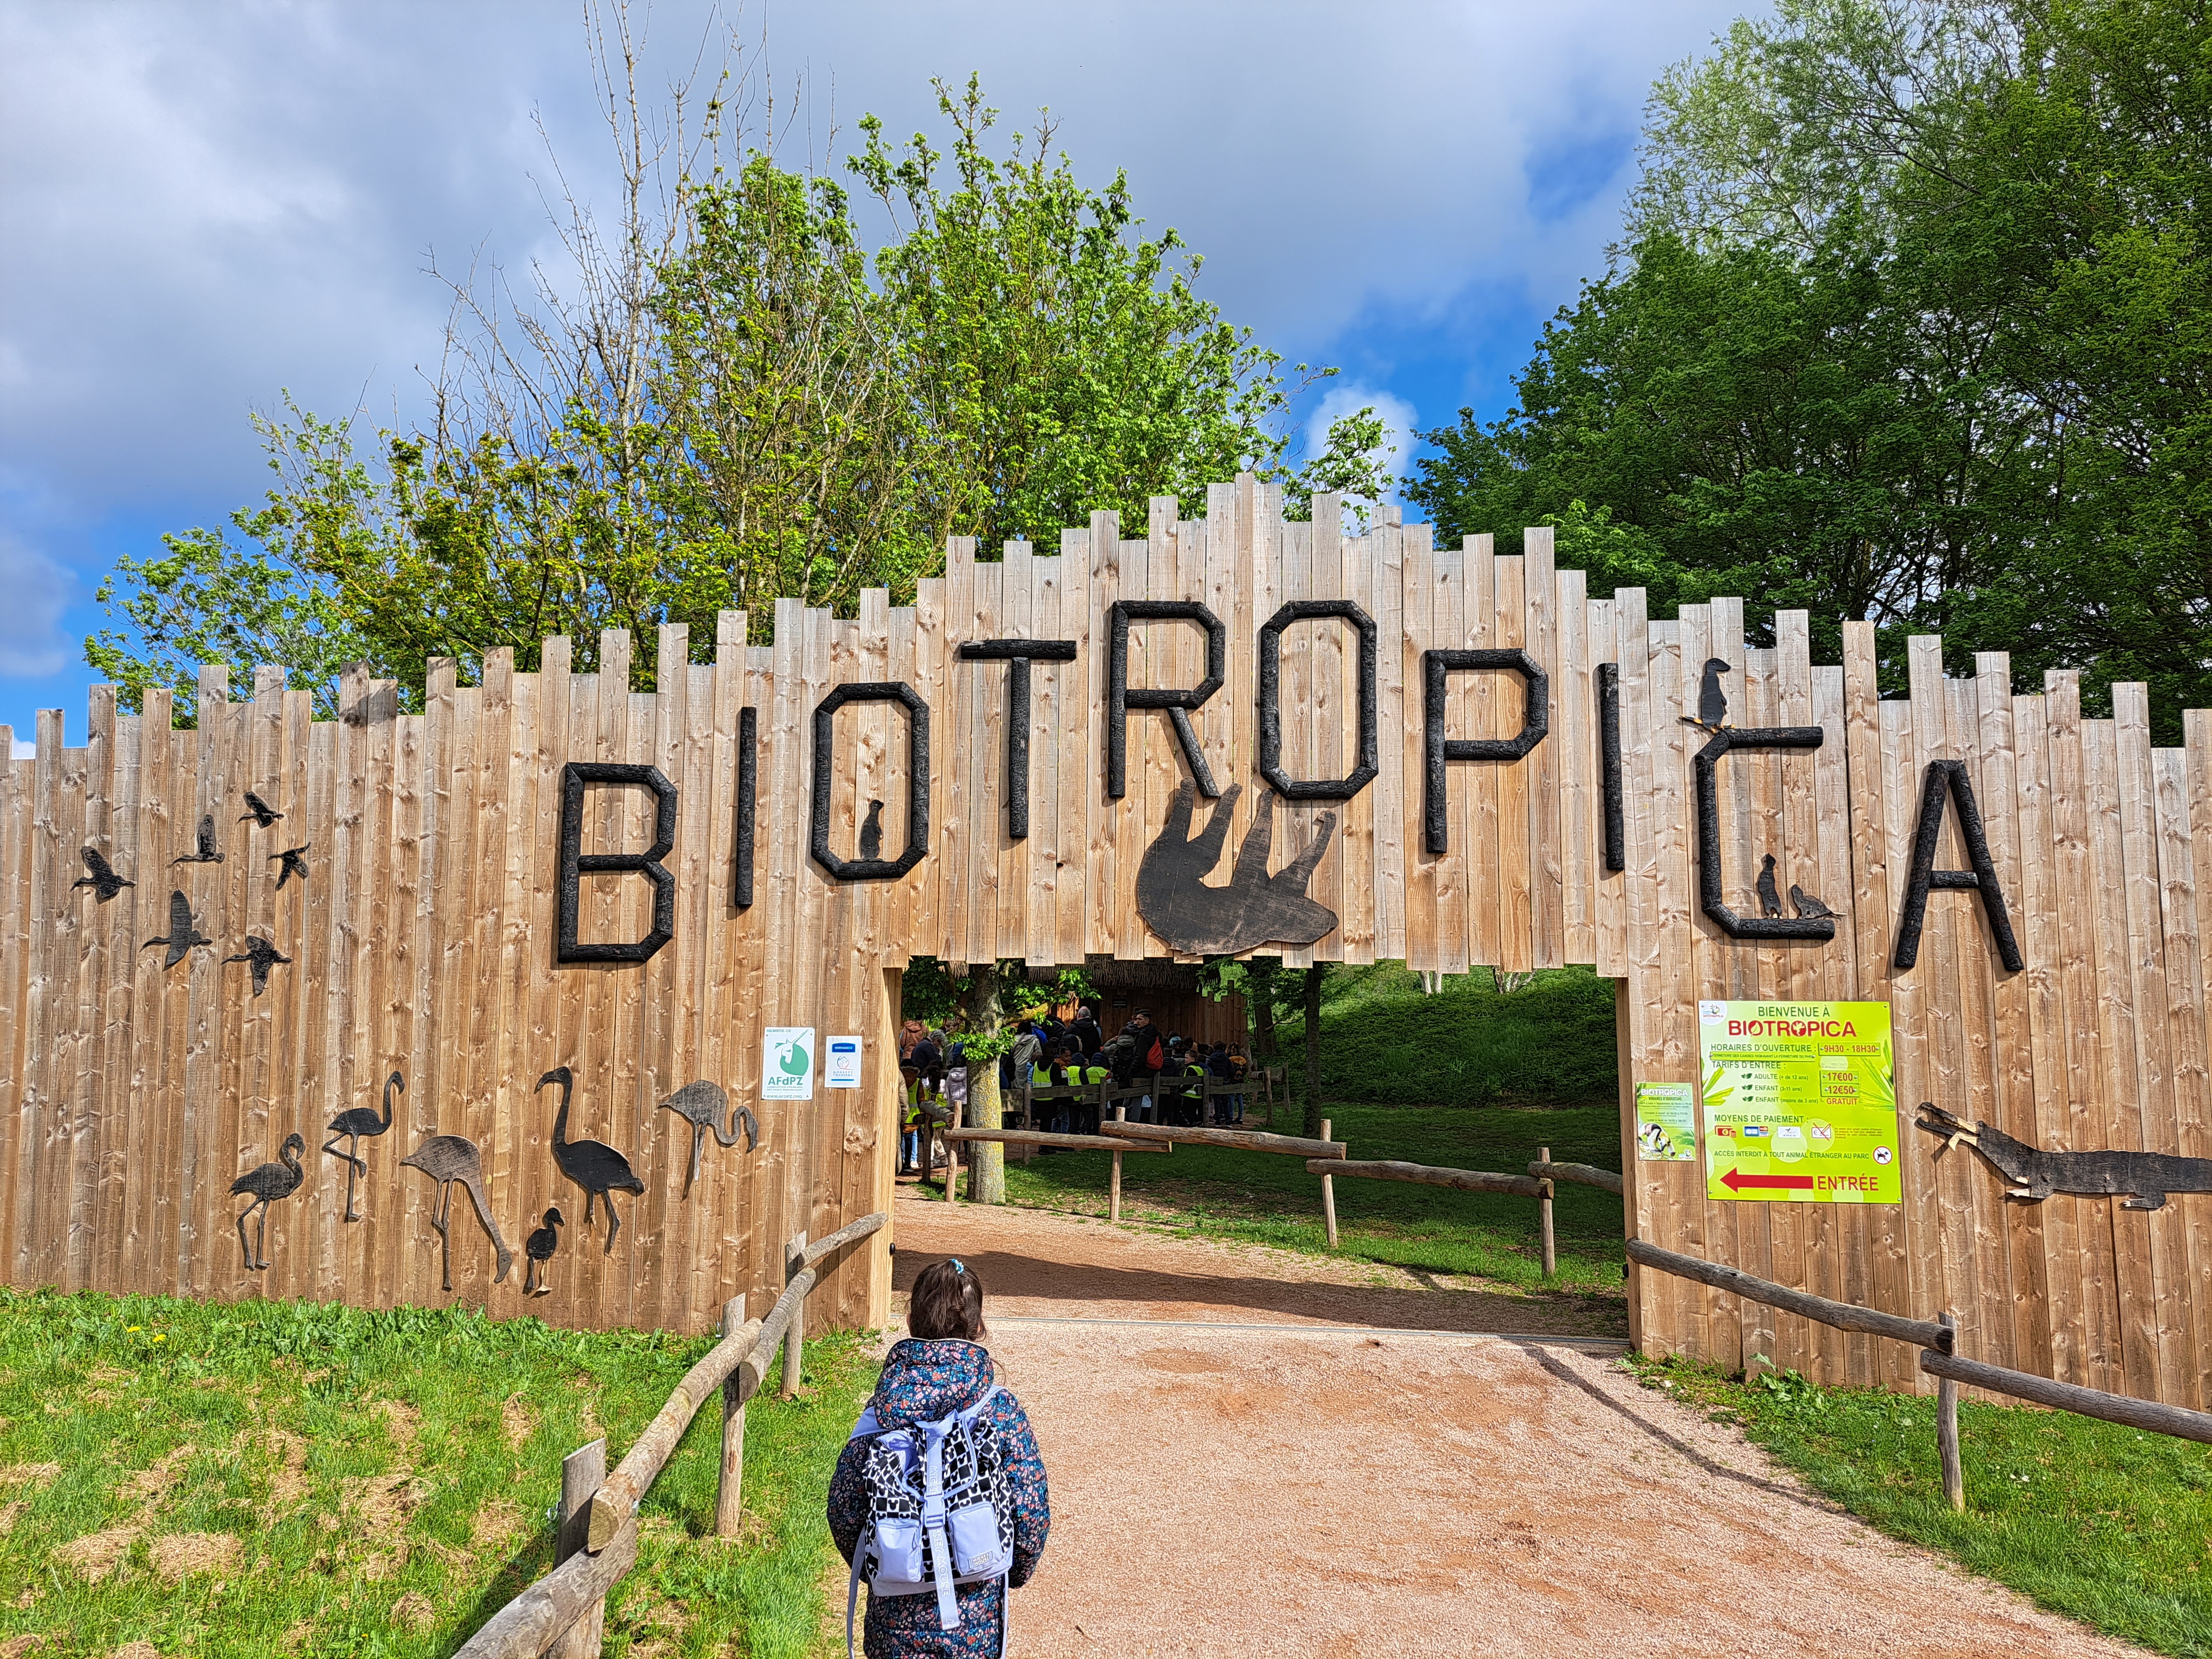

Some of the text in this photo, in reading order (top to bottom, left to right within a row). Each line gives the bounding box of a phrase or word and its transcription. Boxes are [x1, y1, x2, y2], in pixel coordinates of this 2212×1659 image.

[558, 599, 2025, 971] BIOTROPICA
[1758, 1004, 1830, 1017] BIENVENUE À
[1728, 1020, 1857, 1037] BIOTROPICA
[1754, 1044, 1812, 1052] D'OUVERTURE
[1824, 1045, 1844, 1053] 9H30
[1852, 1045, 1876, 1053] 18H30
[767, 1076, 803, 1085] AFdPZ
[1827, 1072, 1853, 1081] 17€00
[1641, 1088, 1688, 1096] BIOTROPICA
[1828, 1085, 1854, 1095] 12€50
[1764, 1115, 1804, 1123] PAIEMENT
[1817, 1173, 1879, 1191] ENTRÉE
[929, 1465, 938, 1495] MICKE
[937, 1556, 951, 1597] MOUSE
